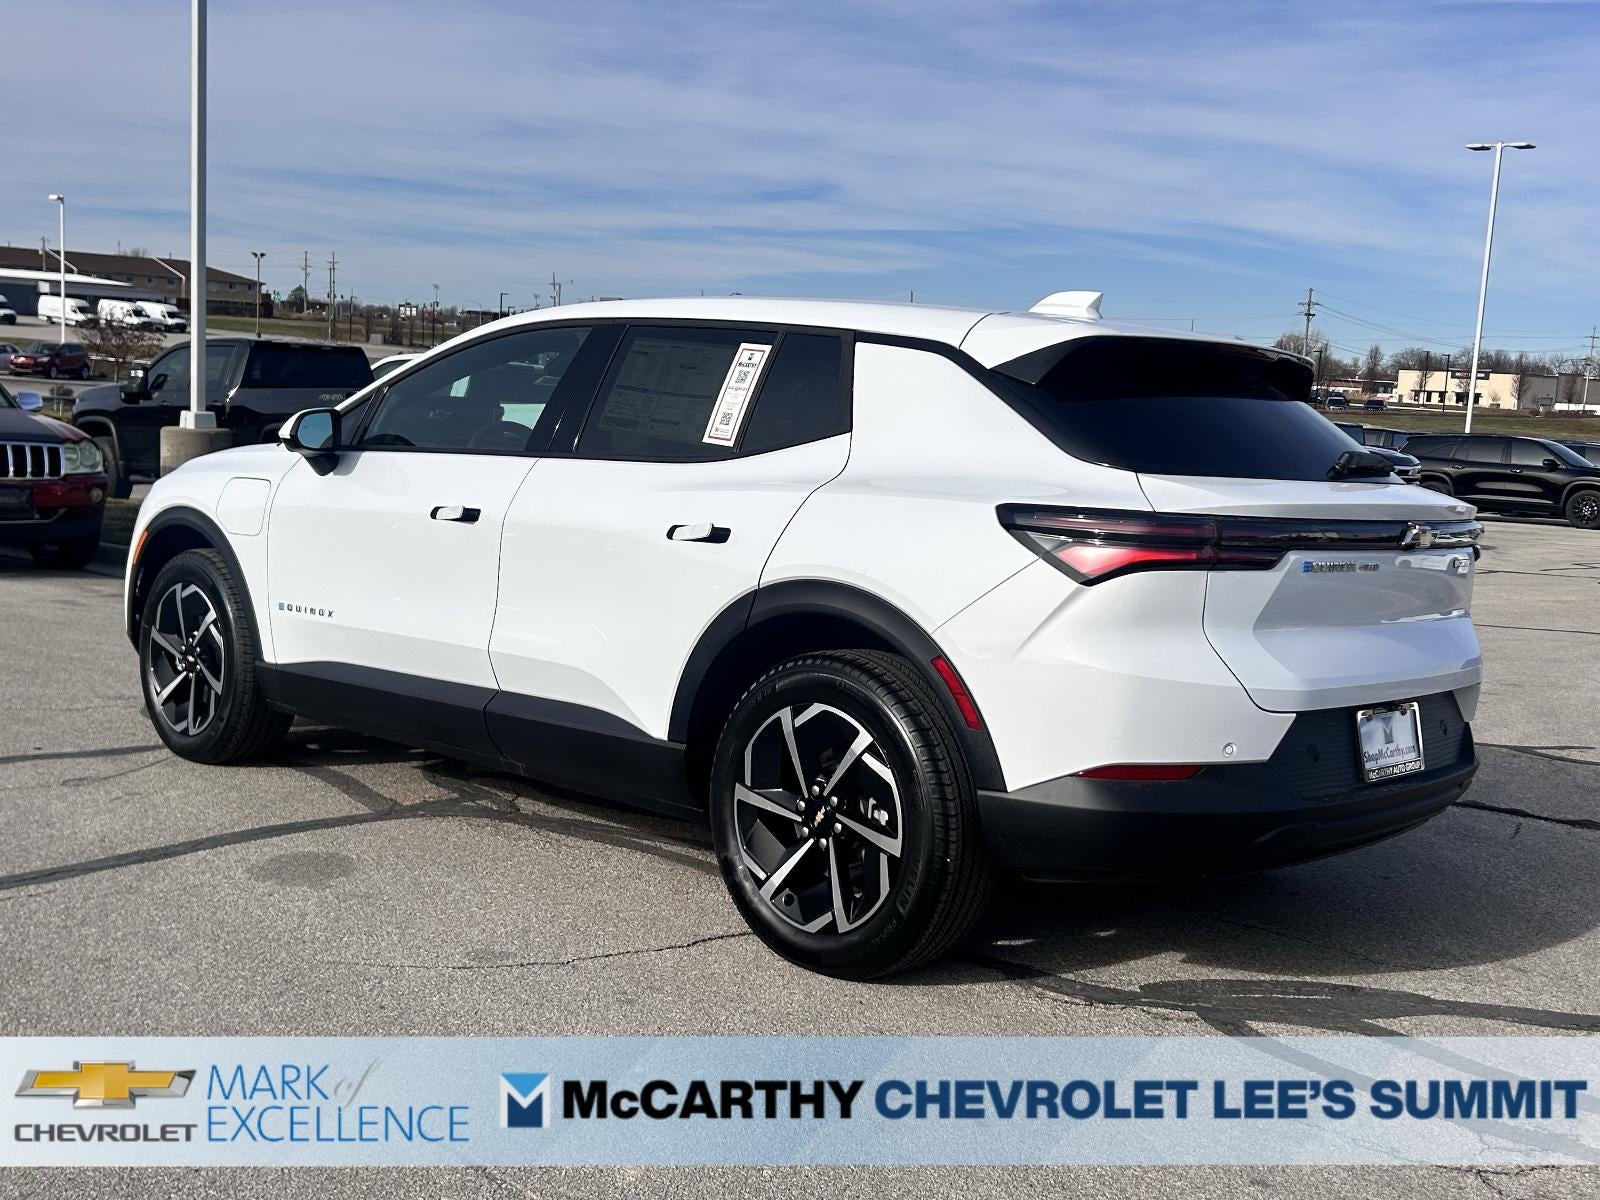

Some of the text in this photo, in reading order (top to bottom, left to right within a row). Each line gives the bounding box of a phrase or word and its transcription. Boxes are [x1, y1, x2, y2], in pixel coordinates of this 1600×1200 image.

[278, 602, 335, 618] EQUINOX
[1363, 745, 1416, 764] ShopMcCarthy.com
[1394, 764, 1405, 773] AUTO
[1406, 761, 1421, 771] GROUP
